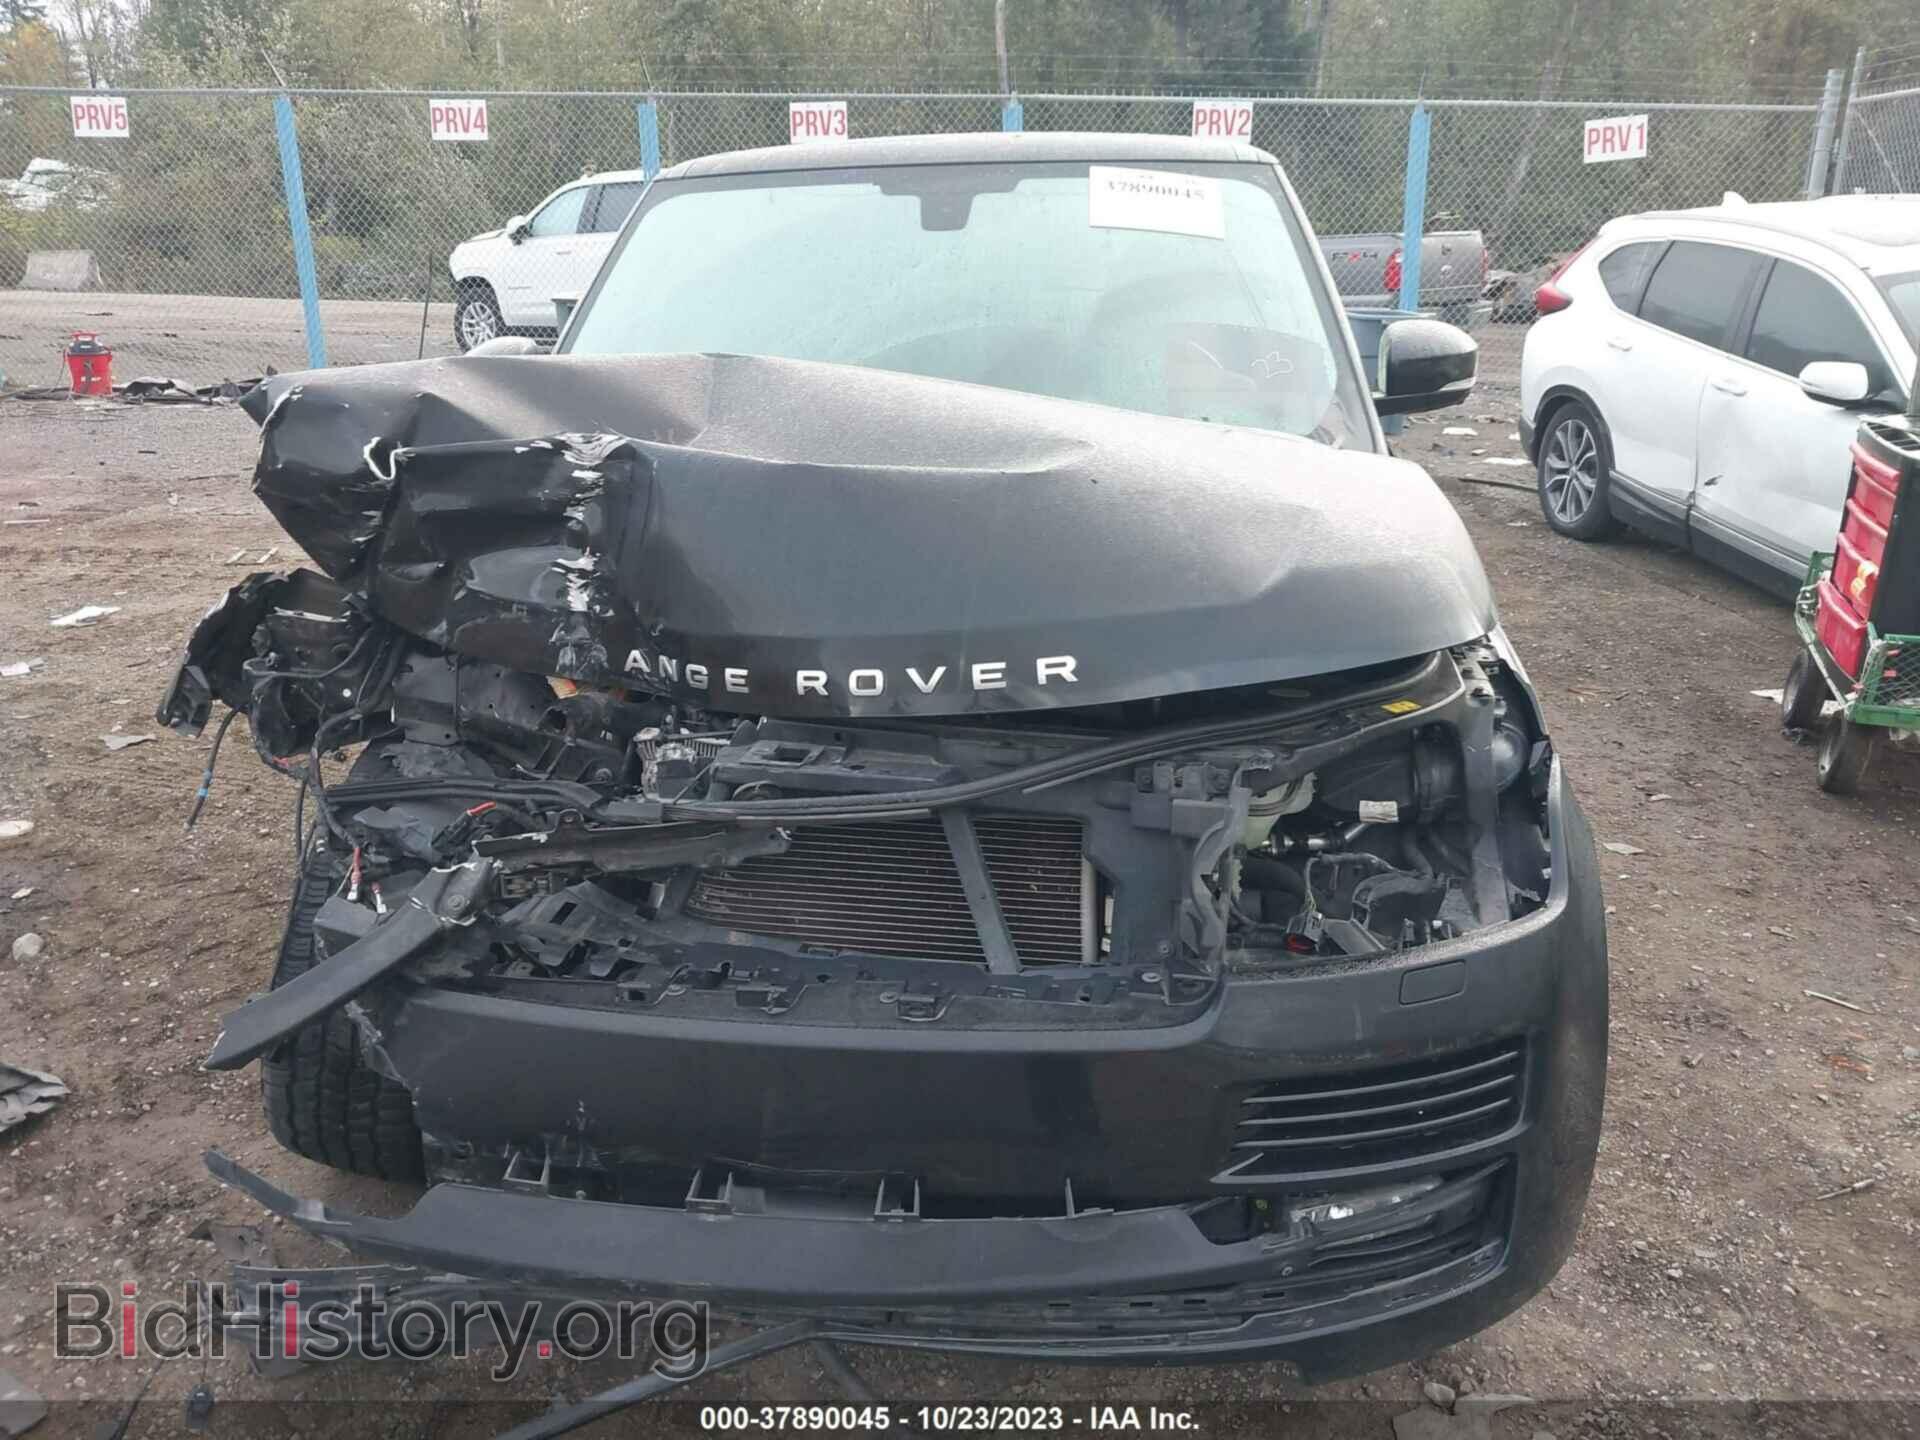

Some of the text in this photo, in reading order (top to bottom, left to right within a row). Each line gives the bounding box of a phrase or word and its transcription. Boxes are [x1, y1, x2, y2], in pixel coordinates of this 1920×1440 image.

[73, 103, 127, 130] PRV5
[432, 106, 486, 133] PRV4
[791, 109, 846, 137] PRV3
[1194, 108, 1250, 136] PRV2
[1586, 122, 1645, 155] PRV1
[796, 655, 1079, 696] ROVER
